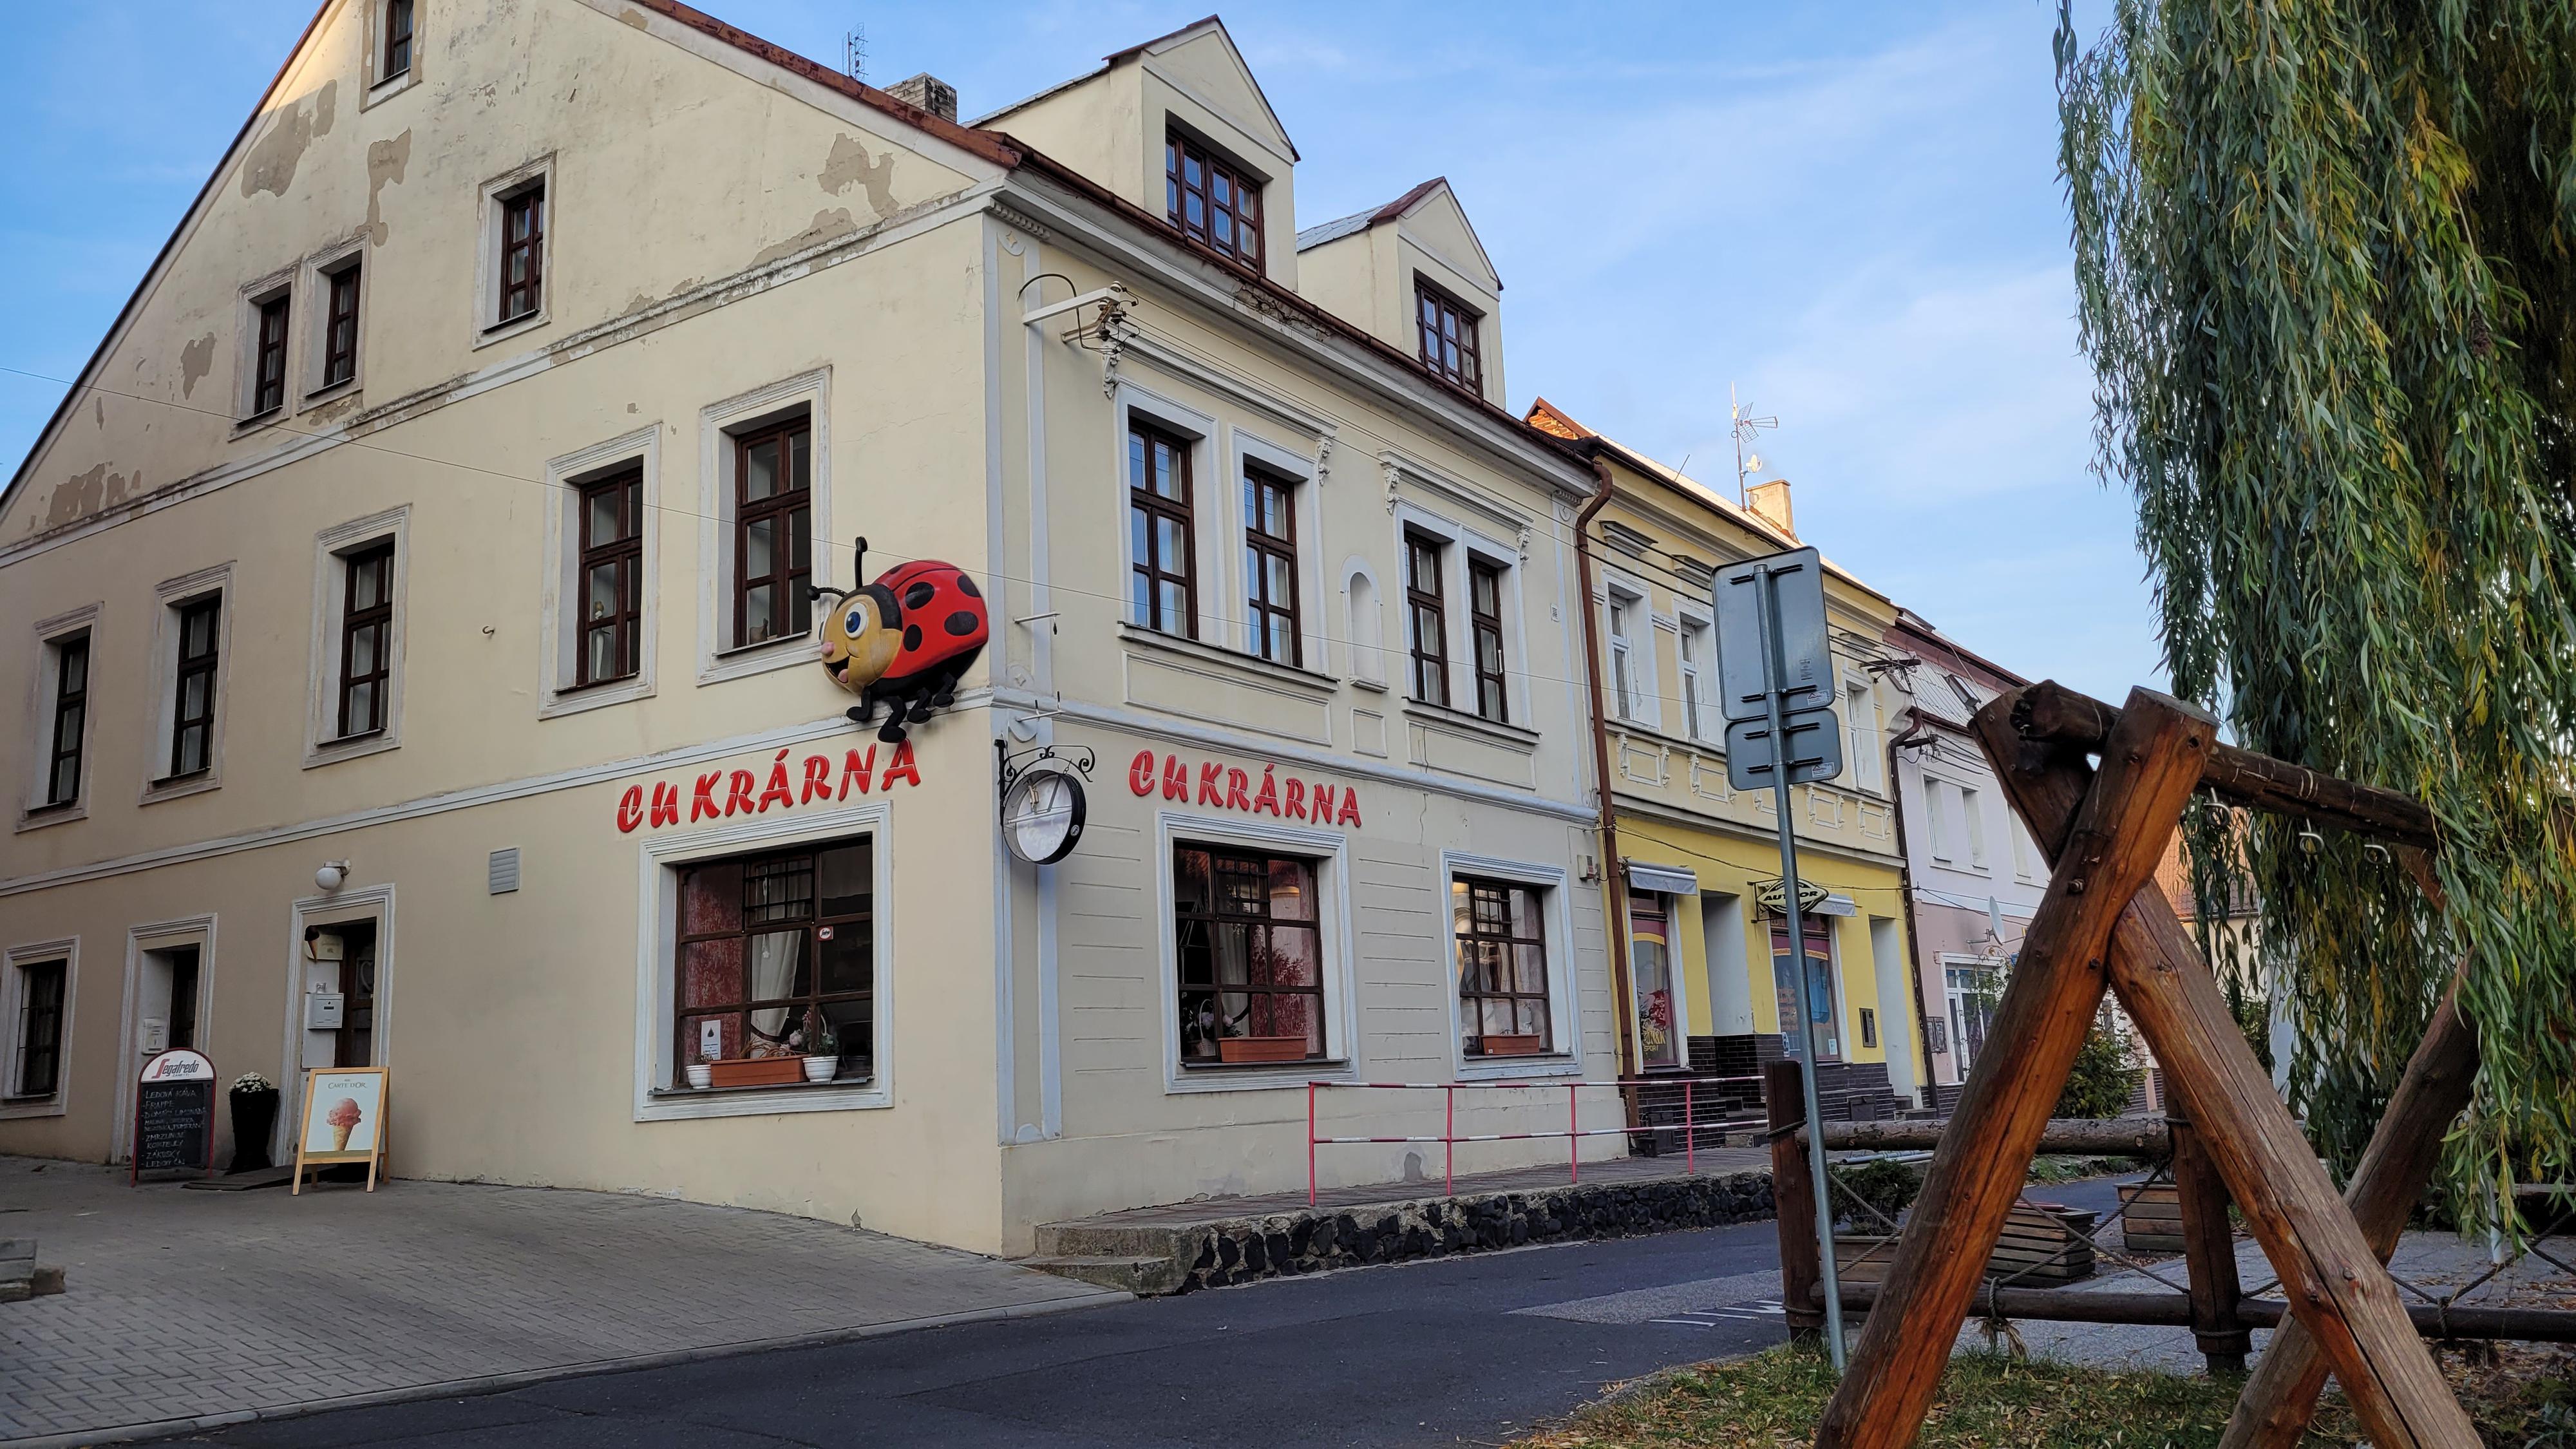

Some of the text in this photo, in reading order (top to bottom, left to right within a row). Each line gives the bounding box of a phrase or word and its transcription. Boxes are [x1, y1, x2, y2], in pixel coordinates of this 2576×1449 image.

[616, 737, 922, 833] CUKRÁRNA
[1128, 748, 1363, 828] CUKRÁRNA
[1763, 891, 1818, 901] AUTOR
[151, 1058, 200, 1079] Segafredo
